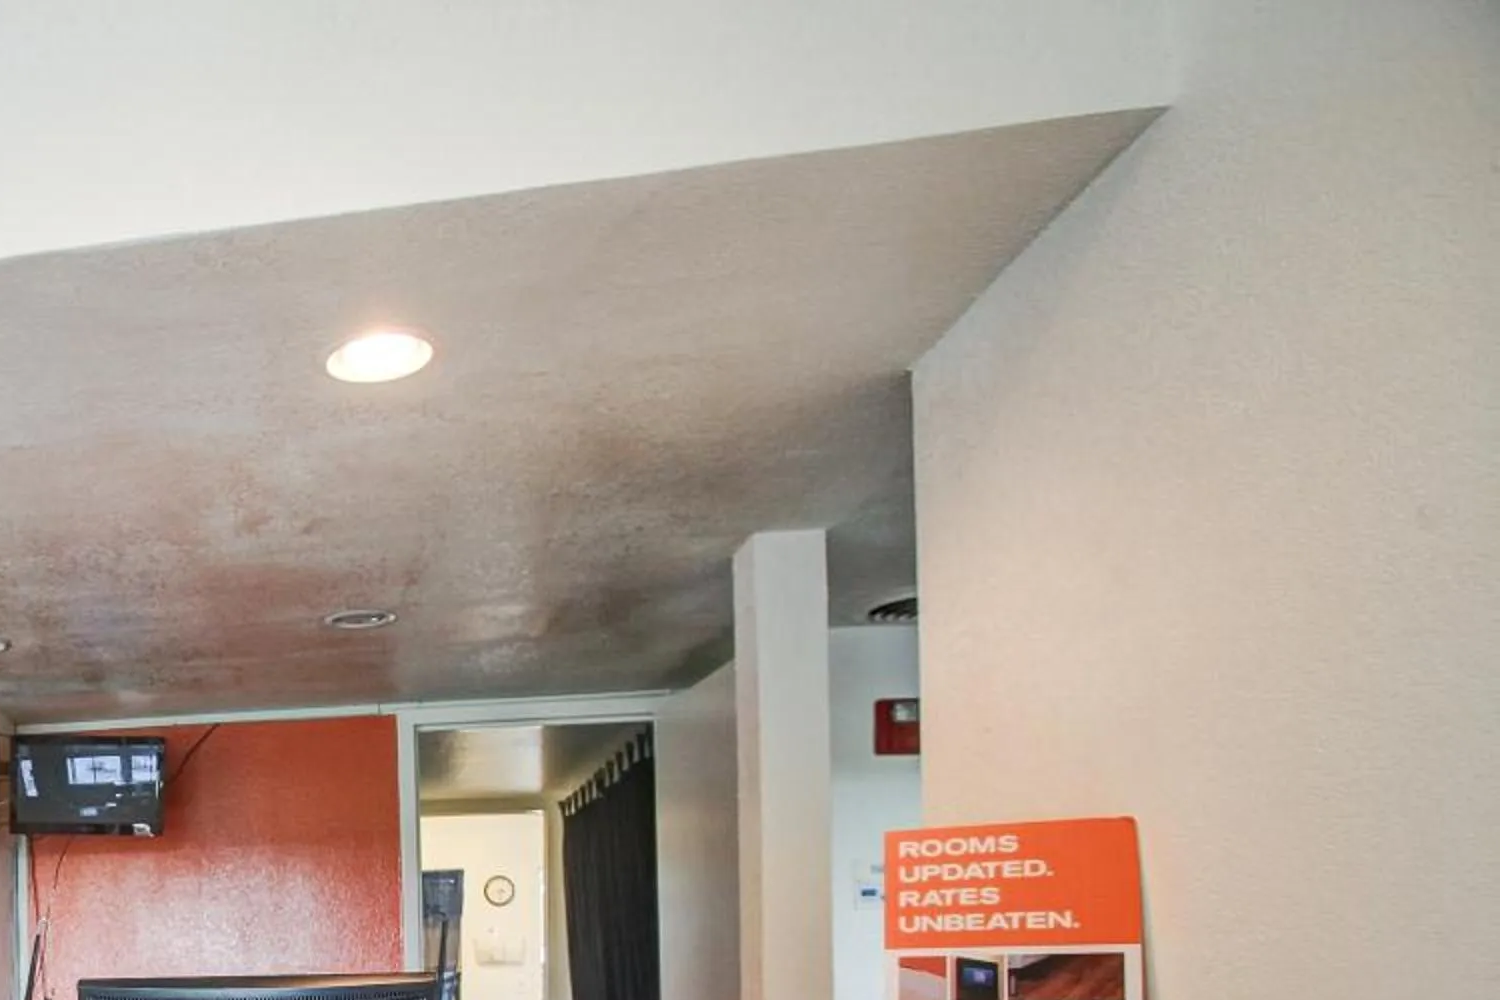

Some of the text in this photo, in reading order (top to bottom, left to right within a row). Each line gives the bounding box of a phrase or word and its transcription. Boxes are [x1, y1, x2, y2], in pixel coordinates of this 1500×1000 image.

[899, 835, 1020, 859] ROOMS
[899, 859, 1054, 883] UPDATED.
[899, 886, 1001, 908] RATES
[899, 910, 1080, 933] UNBEATEN.
